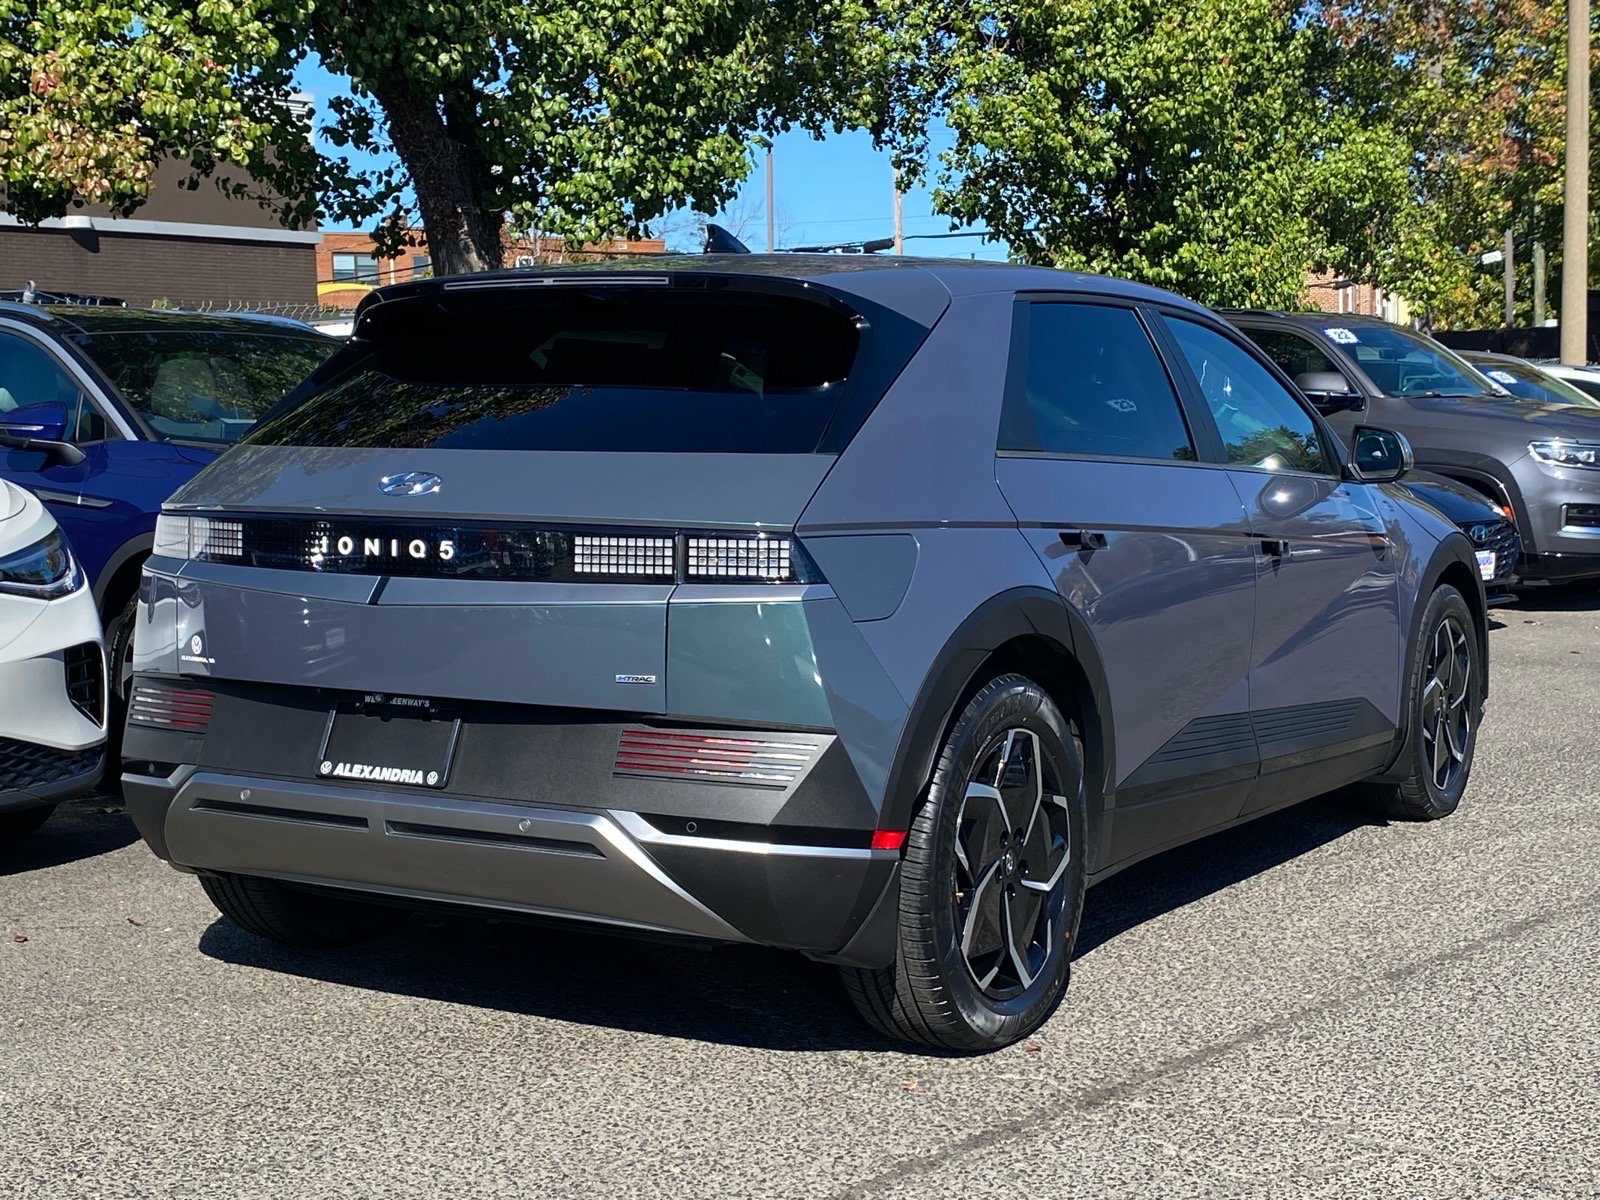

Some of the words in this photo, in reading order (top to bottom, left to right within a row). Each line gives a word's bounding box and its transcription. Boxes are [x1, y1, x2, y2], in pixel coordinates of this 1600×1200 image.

[617, 675, 654, 683] HTRAC
[387, 697, 430, 708] EENWAY'S
[333, 762, 423, 785] ALEXANDRIA
